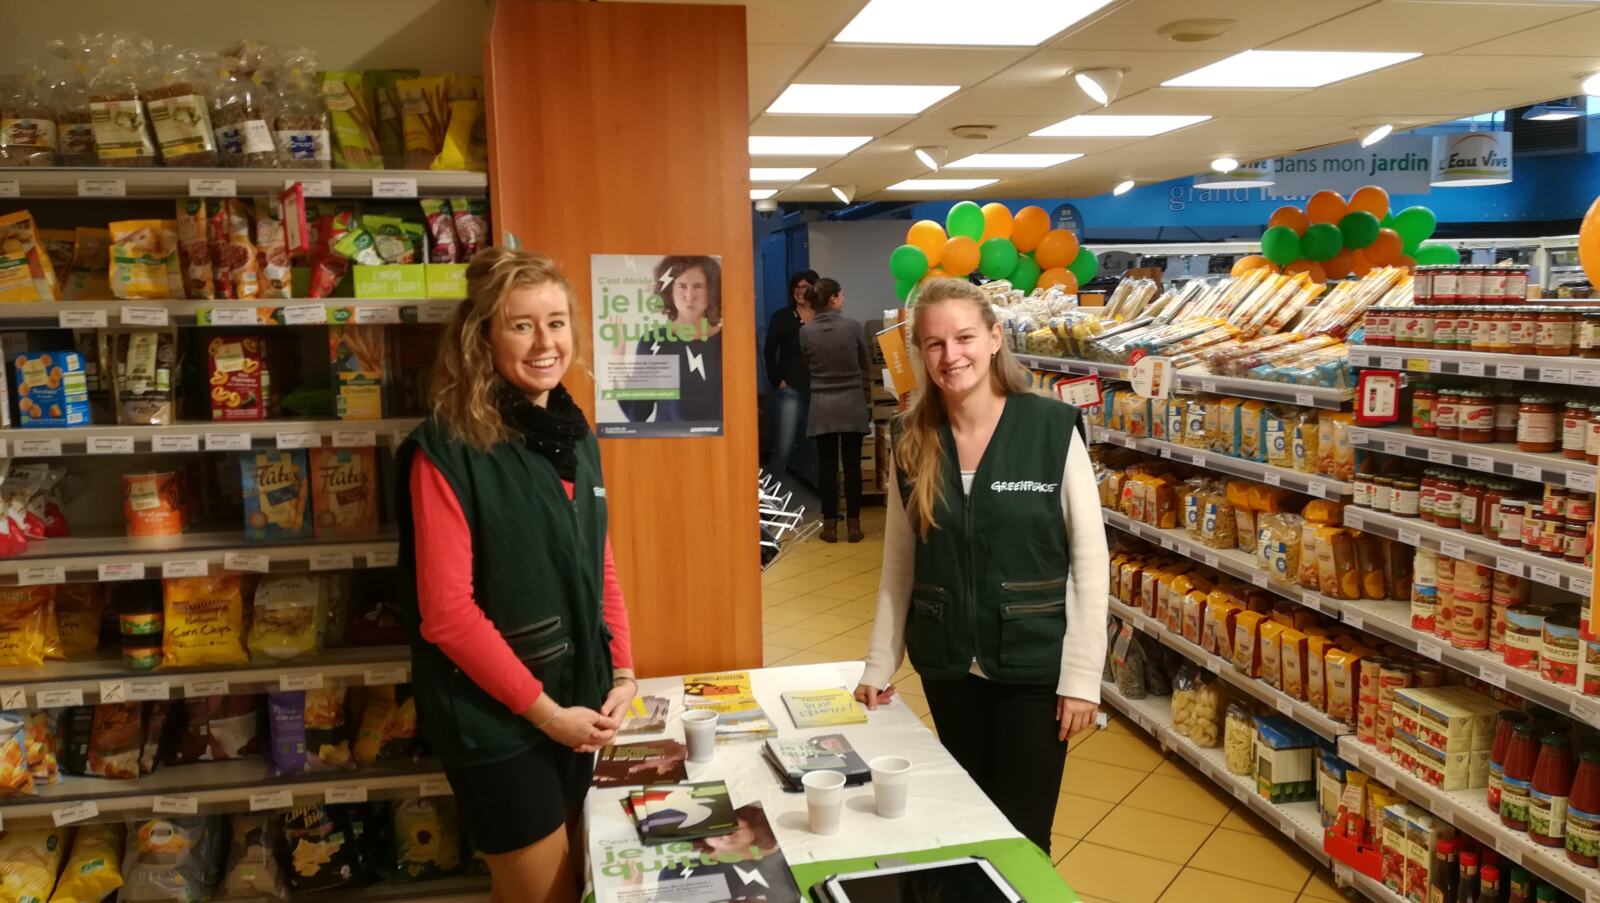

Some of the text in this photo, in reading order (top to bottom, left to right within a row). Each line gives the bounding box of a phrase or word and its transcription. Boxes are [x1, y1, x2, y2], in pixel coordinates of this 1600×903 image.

[1274, 153, 1428, 176] dans mon jardin
[1481, 150, 1508, 167] Vive
[599, 287, 665, 319] je le
[599, 316, 709, 348] quitte!
[990, 480, 1058, 493] GREENPEACE
[171, 623, 232, 638] Corn Chips
[600, 846, 644, 865] je
